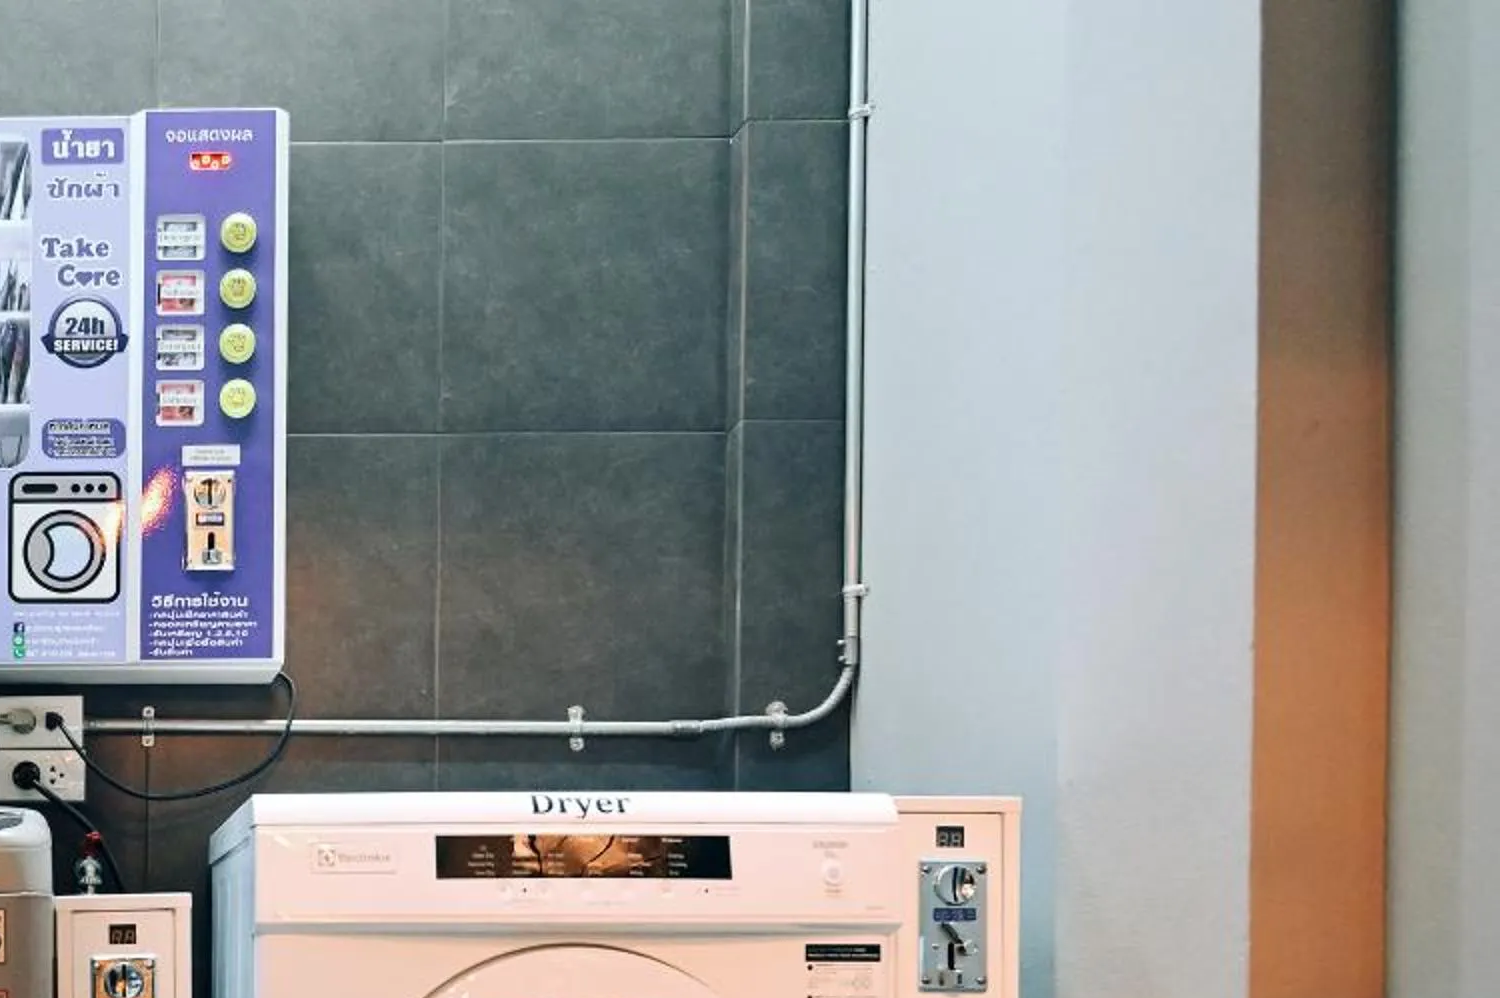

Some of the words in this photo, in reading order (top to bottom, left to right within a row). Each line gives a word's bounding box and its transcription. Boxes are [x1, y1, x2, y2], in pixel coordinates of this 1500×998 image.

[51, 129, 115, 158] น้ำยา
[46, 172, 119, 199] ซักผ้า
[41, 237, 109, 258] Take
[58, 264, 120, 286] Cre
[65, 317, 105, 335] 24h
[53, 339, 117, 351] SERVICE!
[531, 794, 632, 819] Dryer
